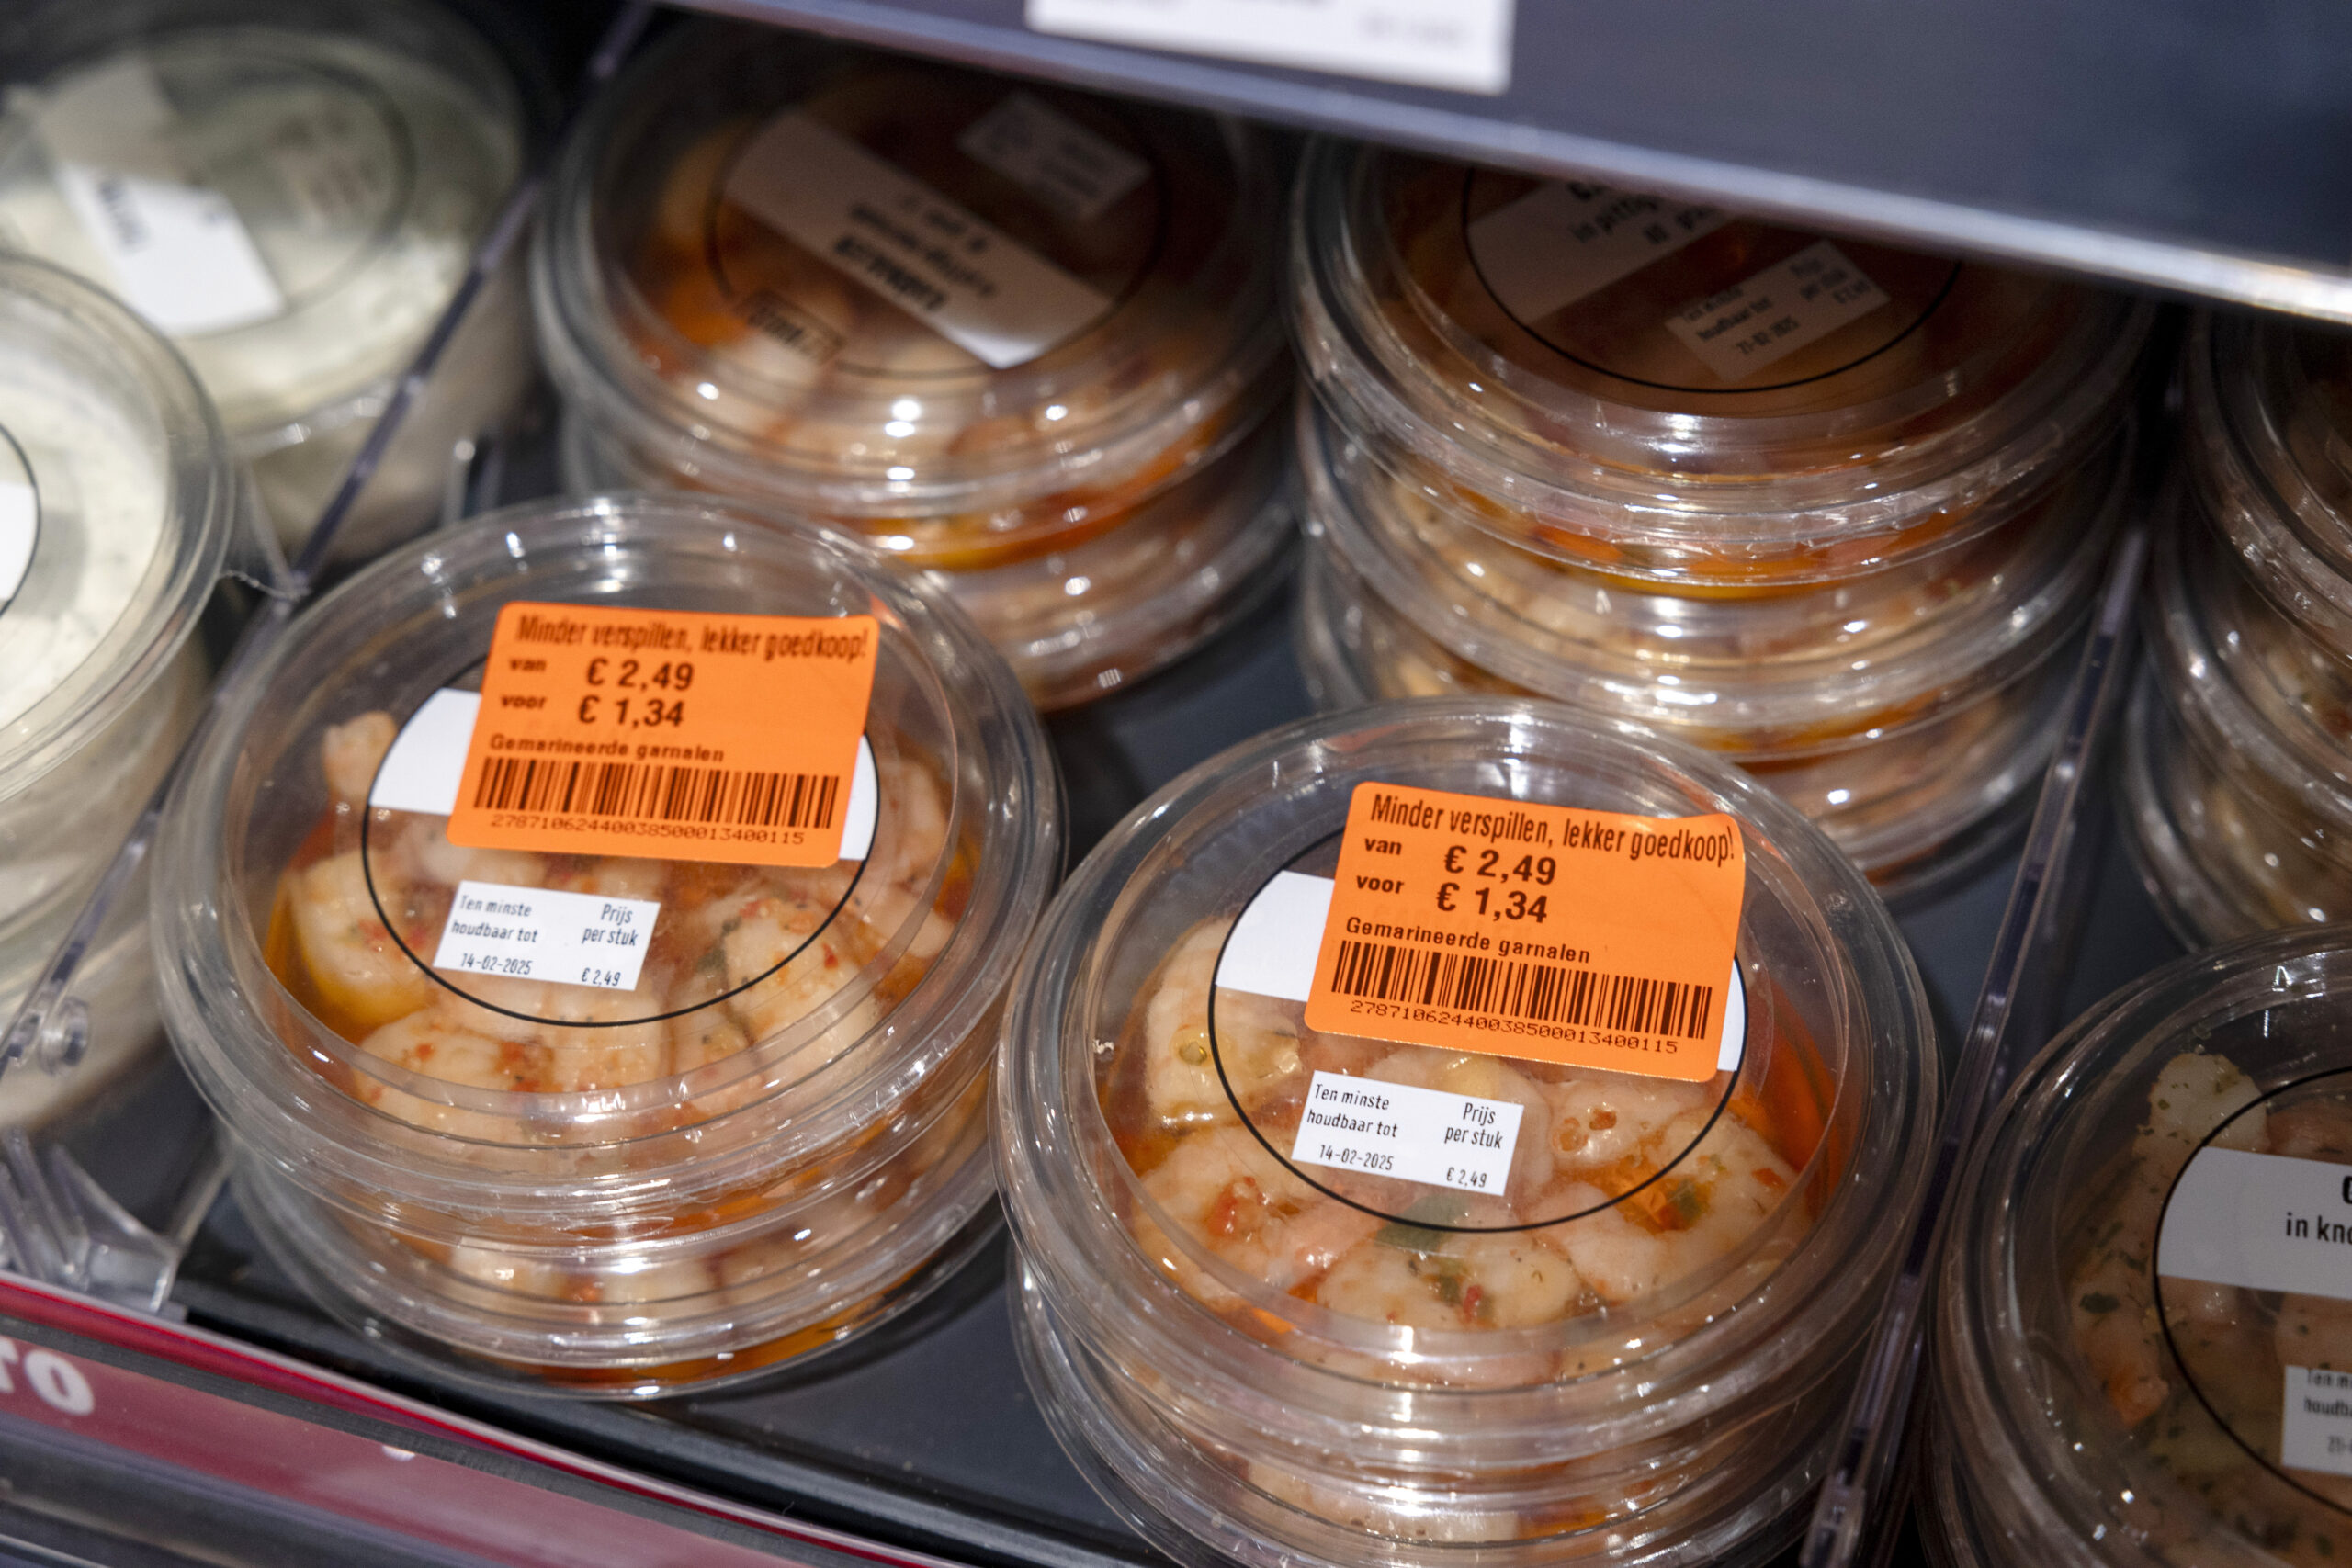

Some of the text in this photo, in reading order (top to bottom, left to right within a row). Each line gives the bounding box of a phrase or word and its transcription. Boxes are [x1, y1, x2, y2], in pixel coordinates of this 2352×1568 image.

[515, 615, 869, 662] Minder verspillen, lekker goedkoop!
[509, 657, 695, 691] van € 2,49
[500, 694, 685, 728] voor € 1,34
[490, 733, 725, 763] Gemarineerde garnalen
[1370, 794, 1735, 867] Minder verspillen, lekker goedkoop!
[1363, 837, 1556, 886] van € 2,49
[459, 895, 532, 917] Ten minste
[1356, 875, 1548, 923] voor € 1,34
[601, 903, 633, 924] Prijs
[451, 919, 538, 943] houdbaar tot
[582, 928, 639, 946] per stuk
[1346, 917, 1590, 964] Gemarineerde garnalen
[460, 953, 532, 976] 14-02-2025
[582, 968, 621, 988] € 2,49
[1350, 1000, 1679, 1055] 27871062440038500013400115
[1315, 1084, 1390, 1111] Ten minste
[1306, 1109, 1399, 1138] houdbaar tot
[1463, 1102, 1496, 1124] Prijs
[1444, 1126, 1503, 1149] per stuk
[1319, 1145, 1394, 1170] 14-02-2025
[1446, 1167, 1487, 1188] € 2,49
[2286, 1212, 2308, 1238] in
[2303, 1396, 2352, 1418] houdb
